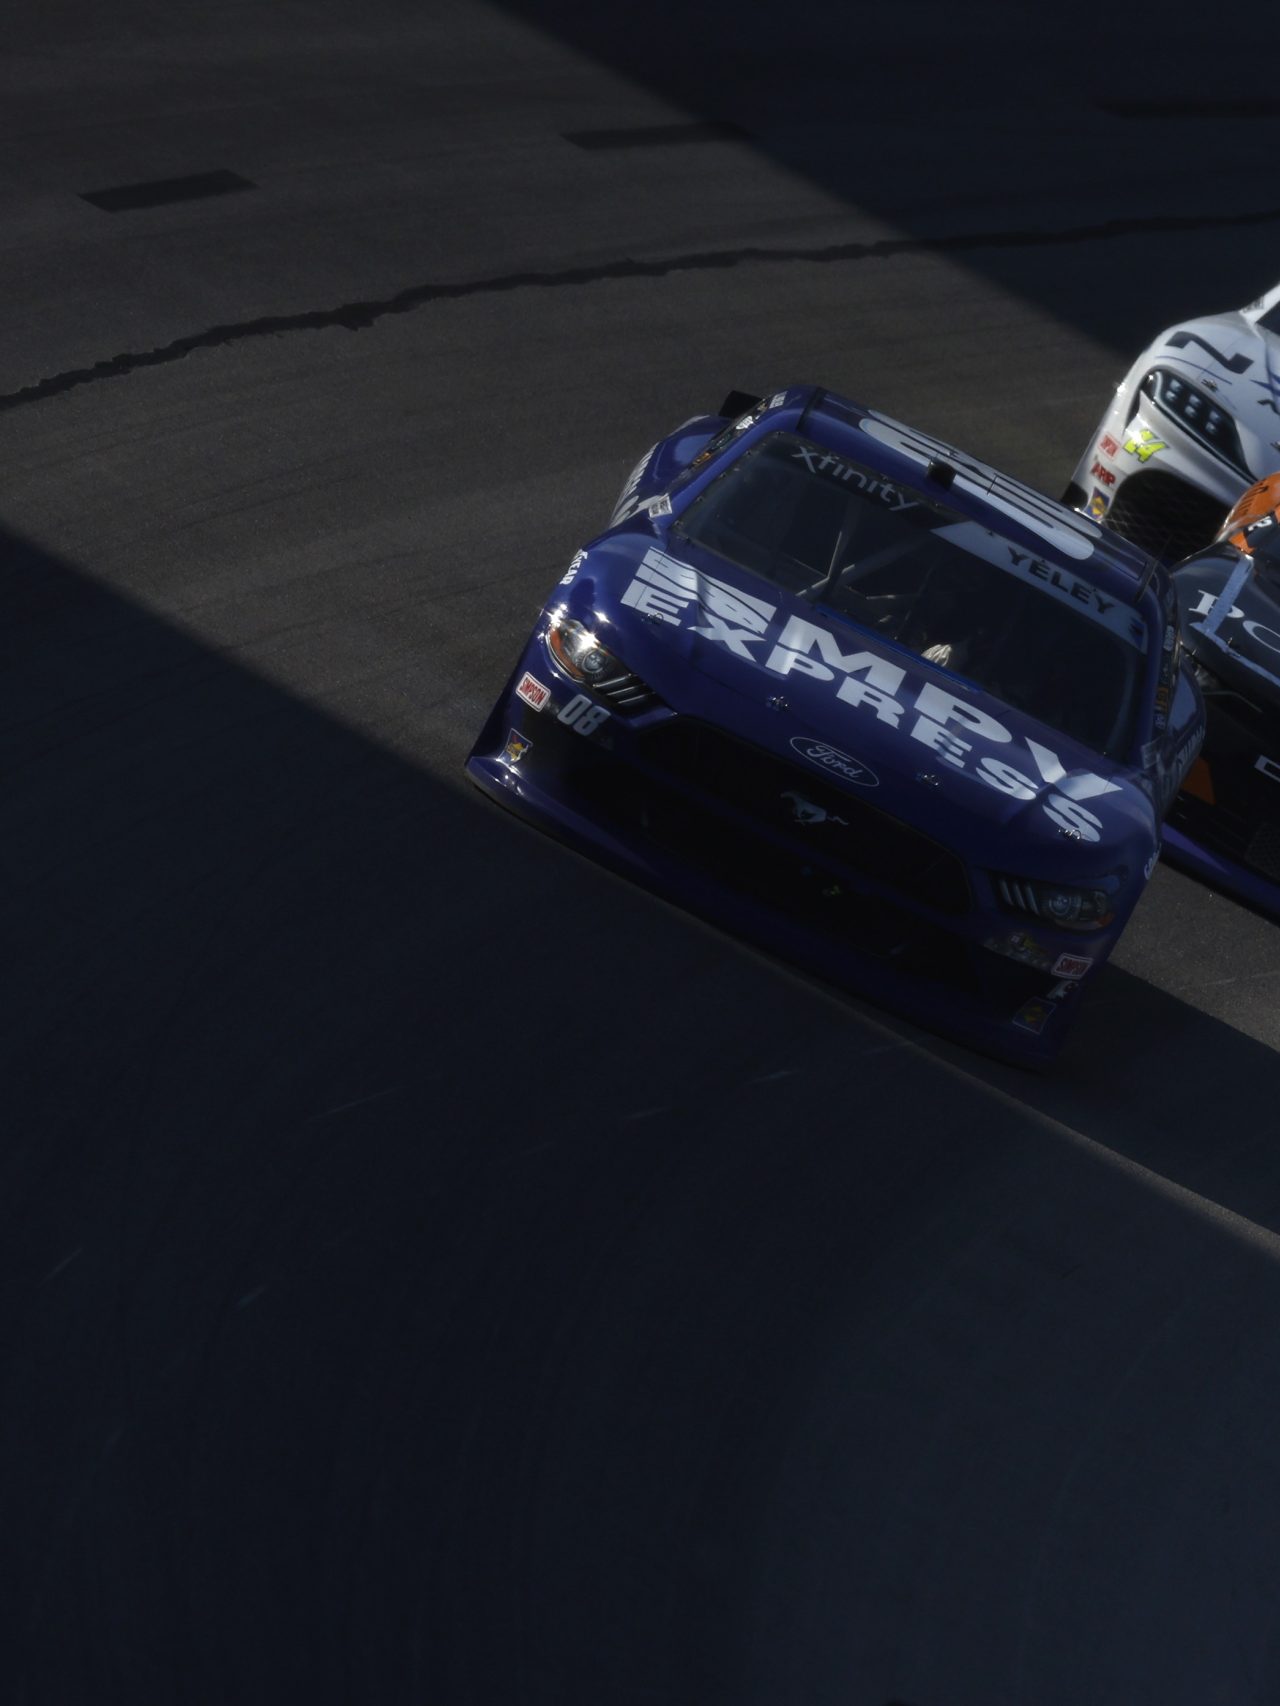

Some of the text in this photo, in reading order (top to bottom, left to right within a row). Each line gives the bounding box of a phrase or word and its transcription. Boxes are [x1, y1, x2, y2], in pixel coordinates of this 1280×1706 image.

[1008, 545, 1115, 614] YELEY
[519, 677, 547, 707] SIMPSON
[620, 578, 1103, 842] EXPRESS
[557, 694, 611, 736] 08
[805, 742, 864, 779] Ford
